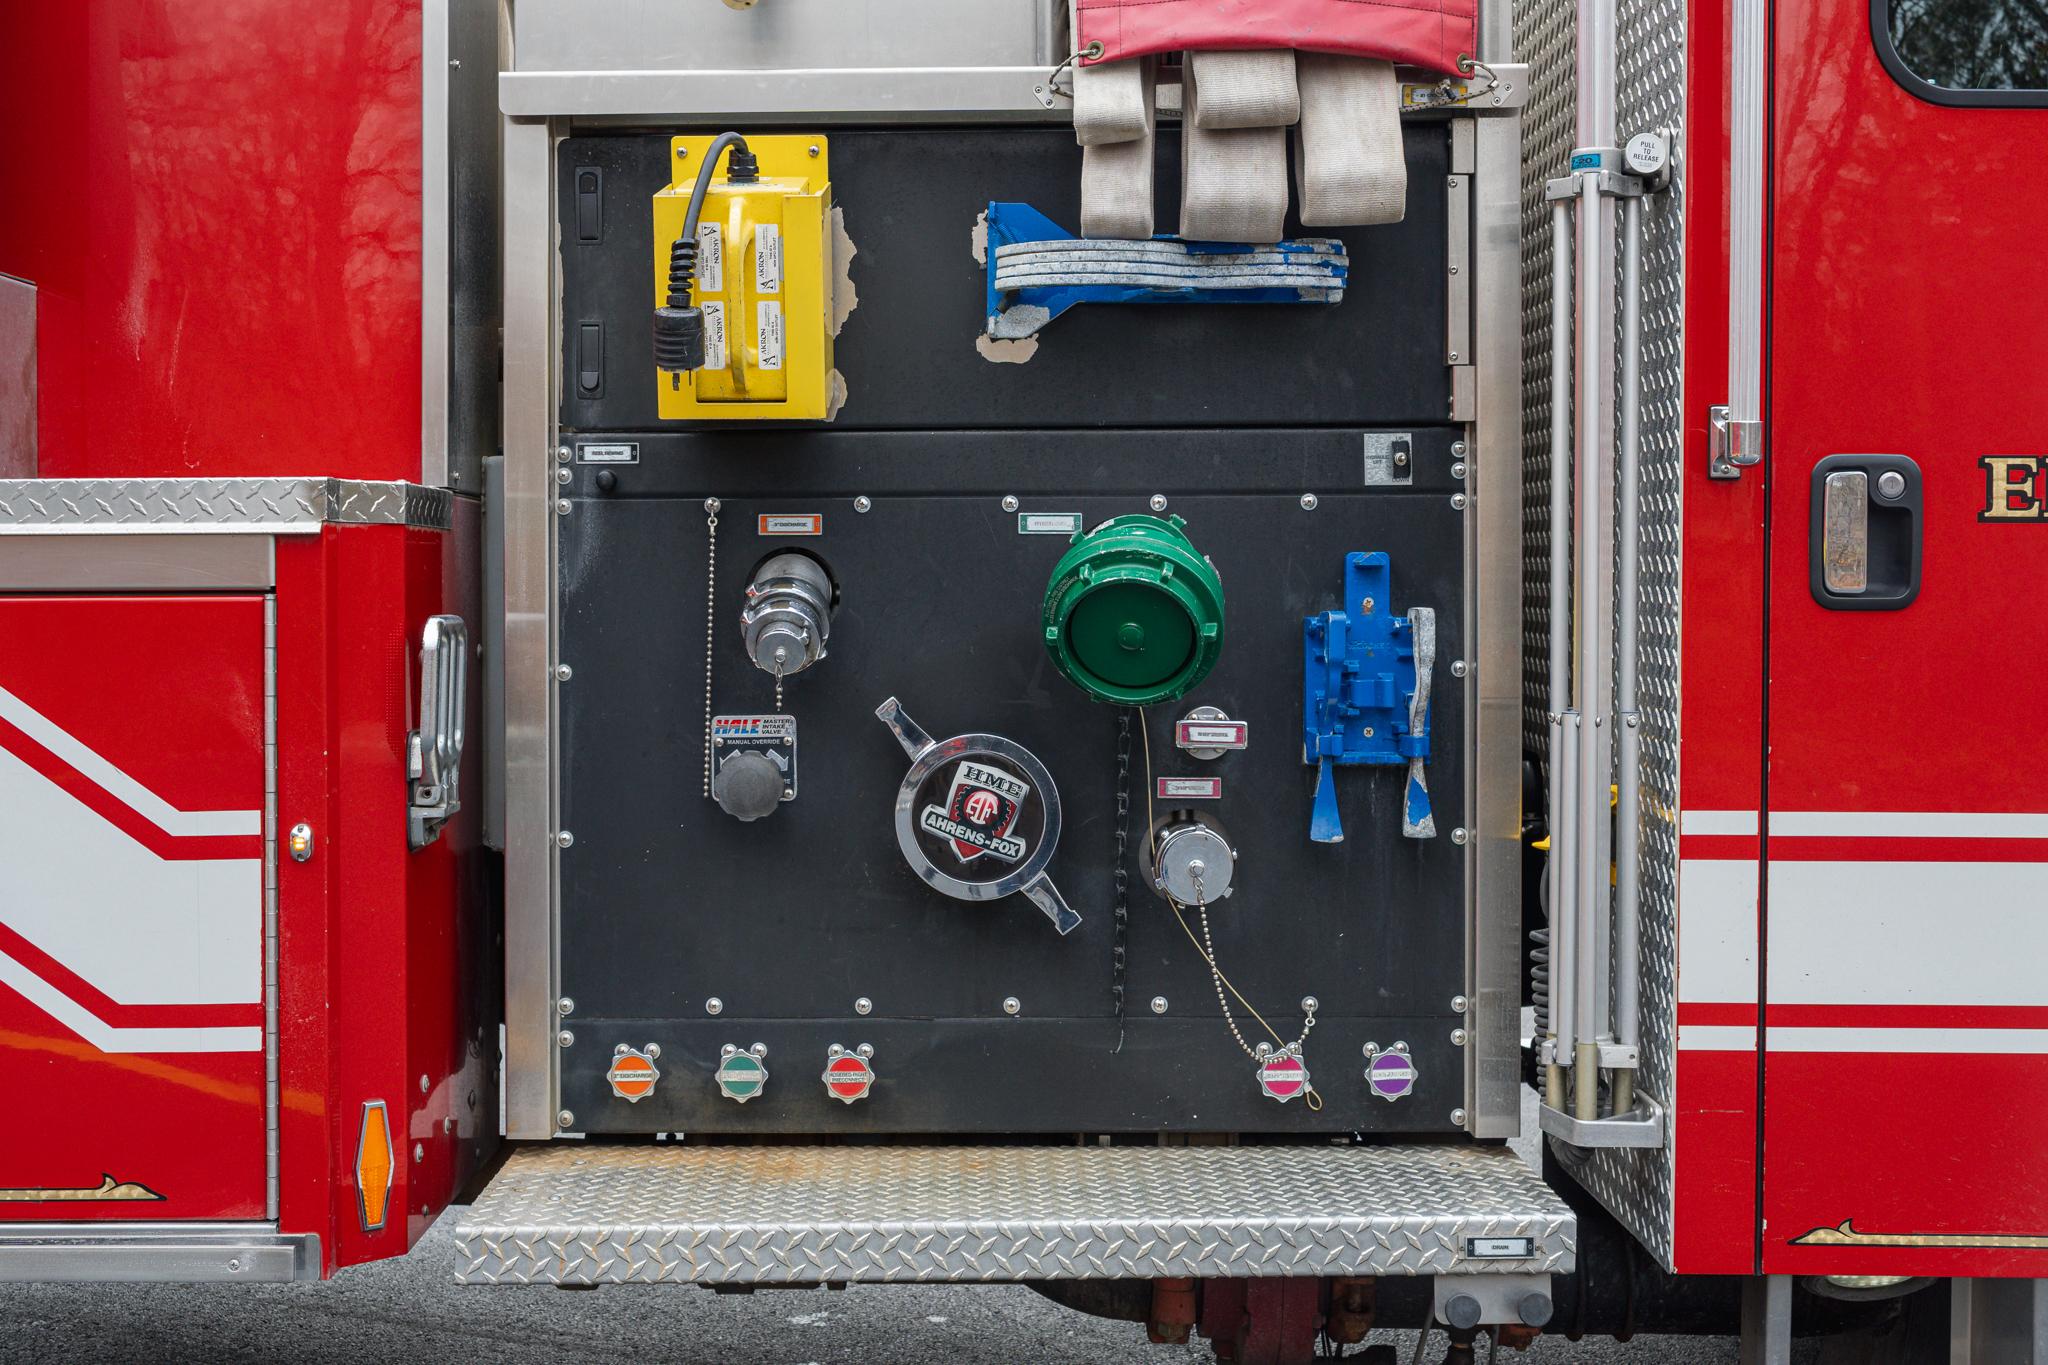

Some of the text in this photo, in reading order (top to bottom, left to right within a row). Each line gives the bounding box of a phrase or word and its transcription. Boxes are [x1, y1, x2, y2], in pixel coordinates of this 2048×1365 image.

[1640, 141, 1656, 149] PULL
[1633, 153, 1659, 163] RELEASE
[1978, 456, 2048, 523] E
[713, 719, 762, 735] HALE
[963, 765, 1024, 798] HME
[926, 814, 1020, 857] AHRENS-FOX
